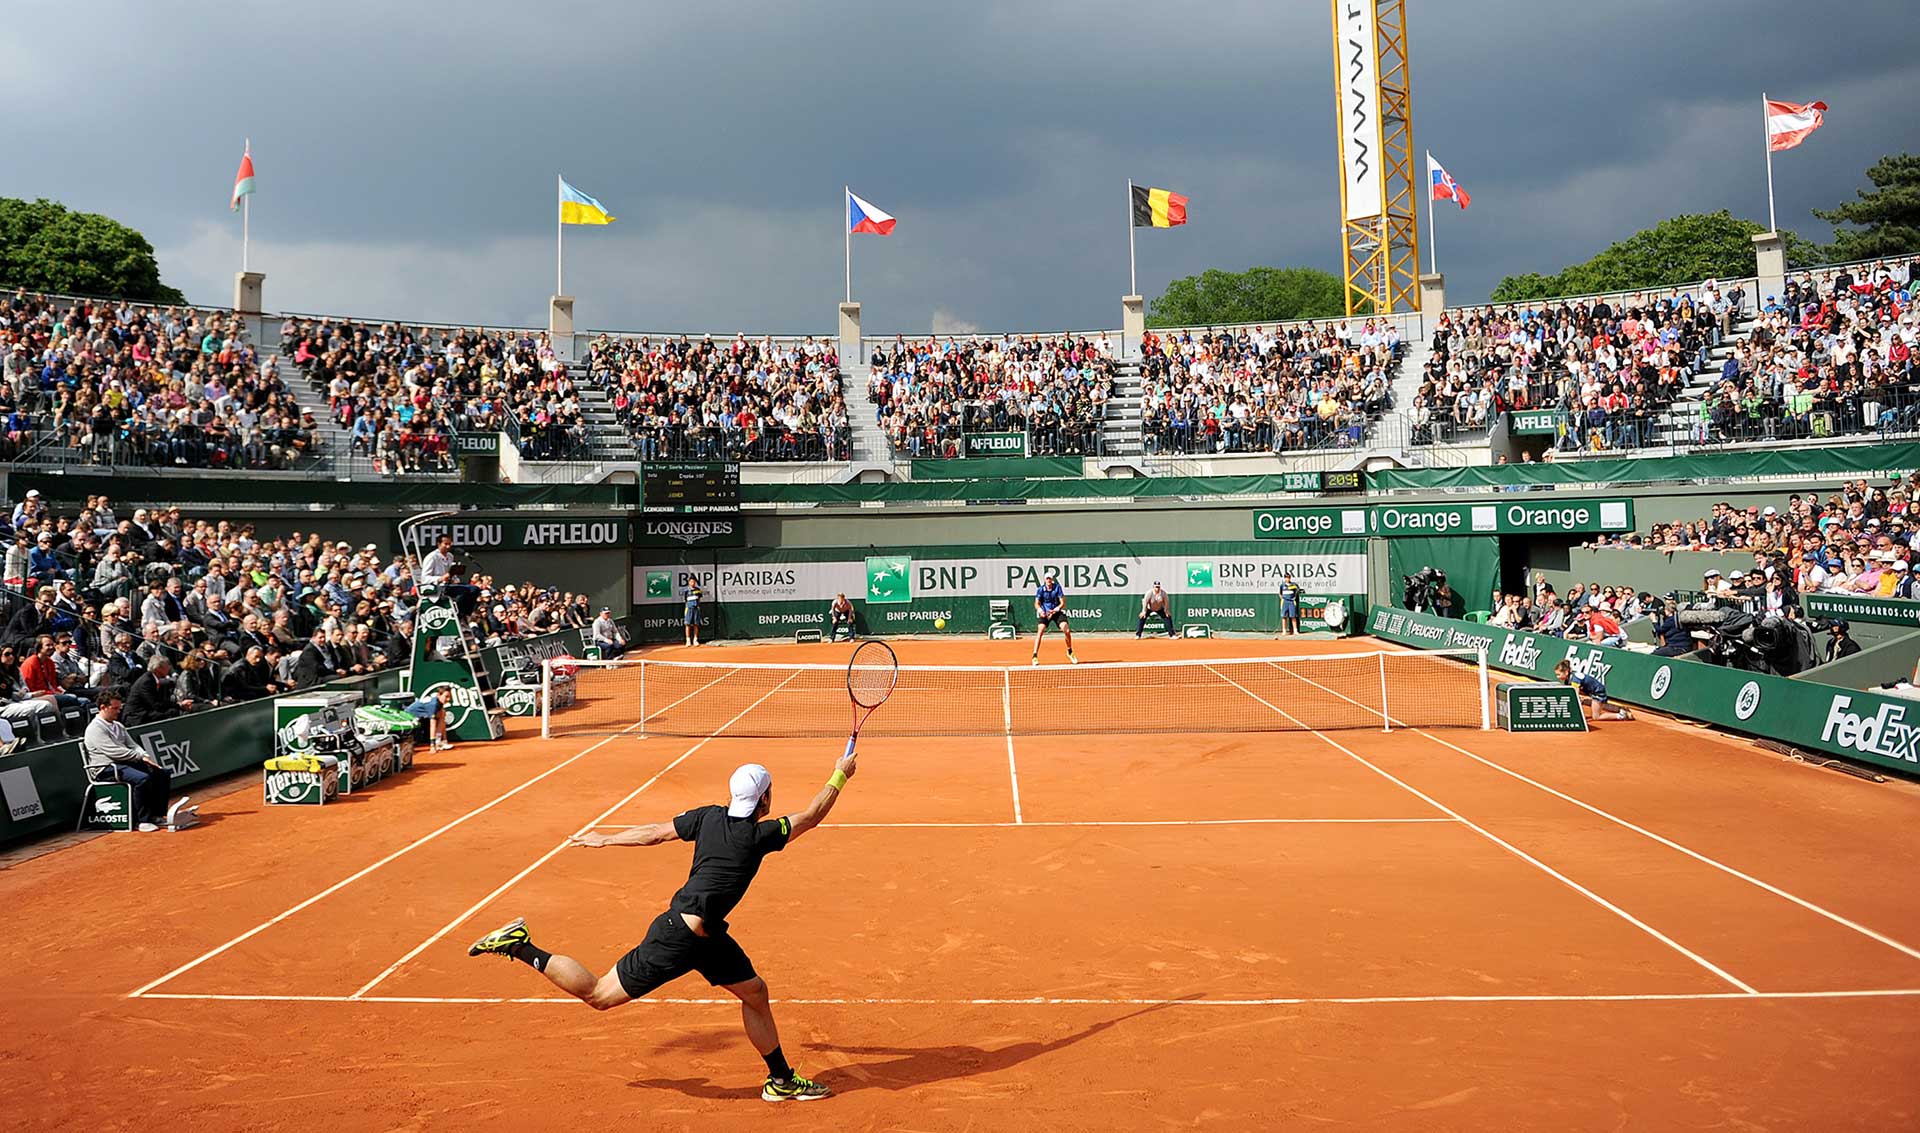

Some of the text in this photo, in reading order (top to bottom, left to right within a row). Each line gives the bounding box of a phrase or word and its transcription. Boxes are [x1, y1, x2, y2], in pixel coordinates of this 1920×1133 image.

[970, 438, 1021, 450] AFFLELOU
[1284, 474, 1319, 489] IBM
[1258, 513, 1332, 534] Orange
[1383, 509, 1461, 532] Orange
[1507, 505, 1589, 529] Orange
[523, 523, 618, 545] AFFLELOU
[646, 521, 733, 535] LONGINES
[678, 570, 795, 587] BNP PARIBAS
[919, 563, 1129, 591] BNP PARIBAS
[1219, 562, 1338, 578] BNP PARIBAS
[758, 613, 824, 625] BNP PARIBAS
[887, 610, 952, 621] BNP PARIBAS
[1187, 607, 1256, 618] BNP PARIBAS
[1373, 610, 1391, 632] IBM
[644, 618, 666, 628] BNP
[1387, 613, 1406, 636] IBM
[1410, 623, 1445, 641] PEUGEOT
[1452, 631, 1494, 652] PEUGEOT
[1498, 633, 1542, 671] FedEx
[1564, 645, 1612, 685] FedEx
[1518, 696, 1571, 718] IBM
[1821, 694, 1920, 763] FedEx
[12, 801, 41, 817] orange
[88, 814, 128, 823] LACOSTE
